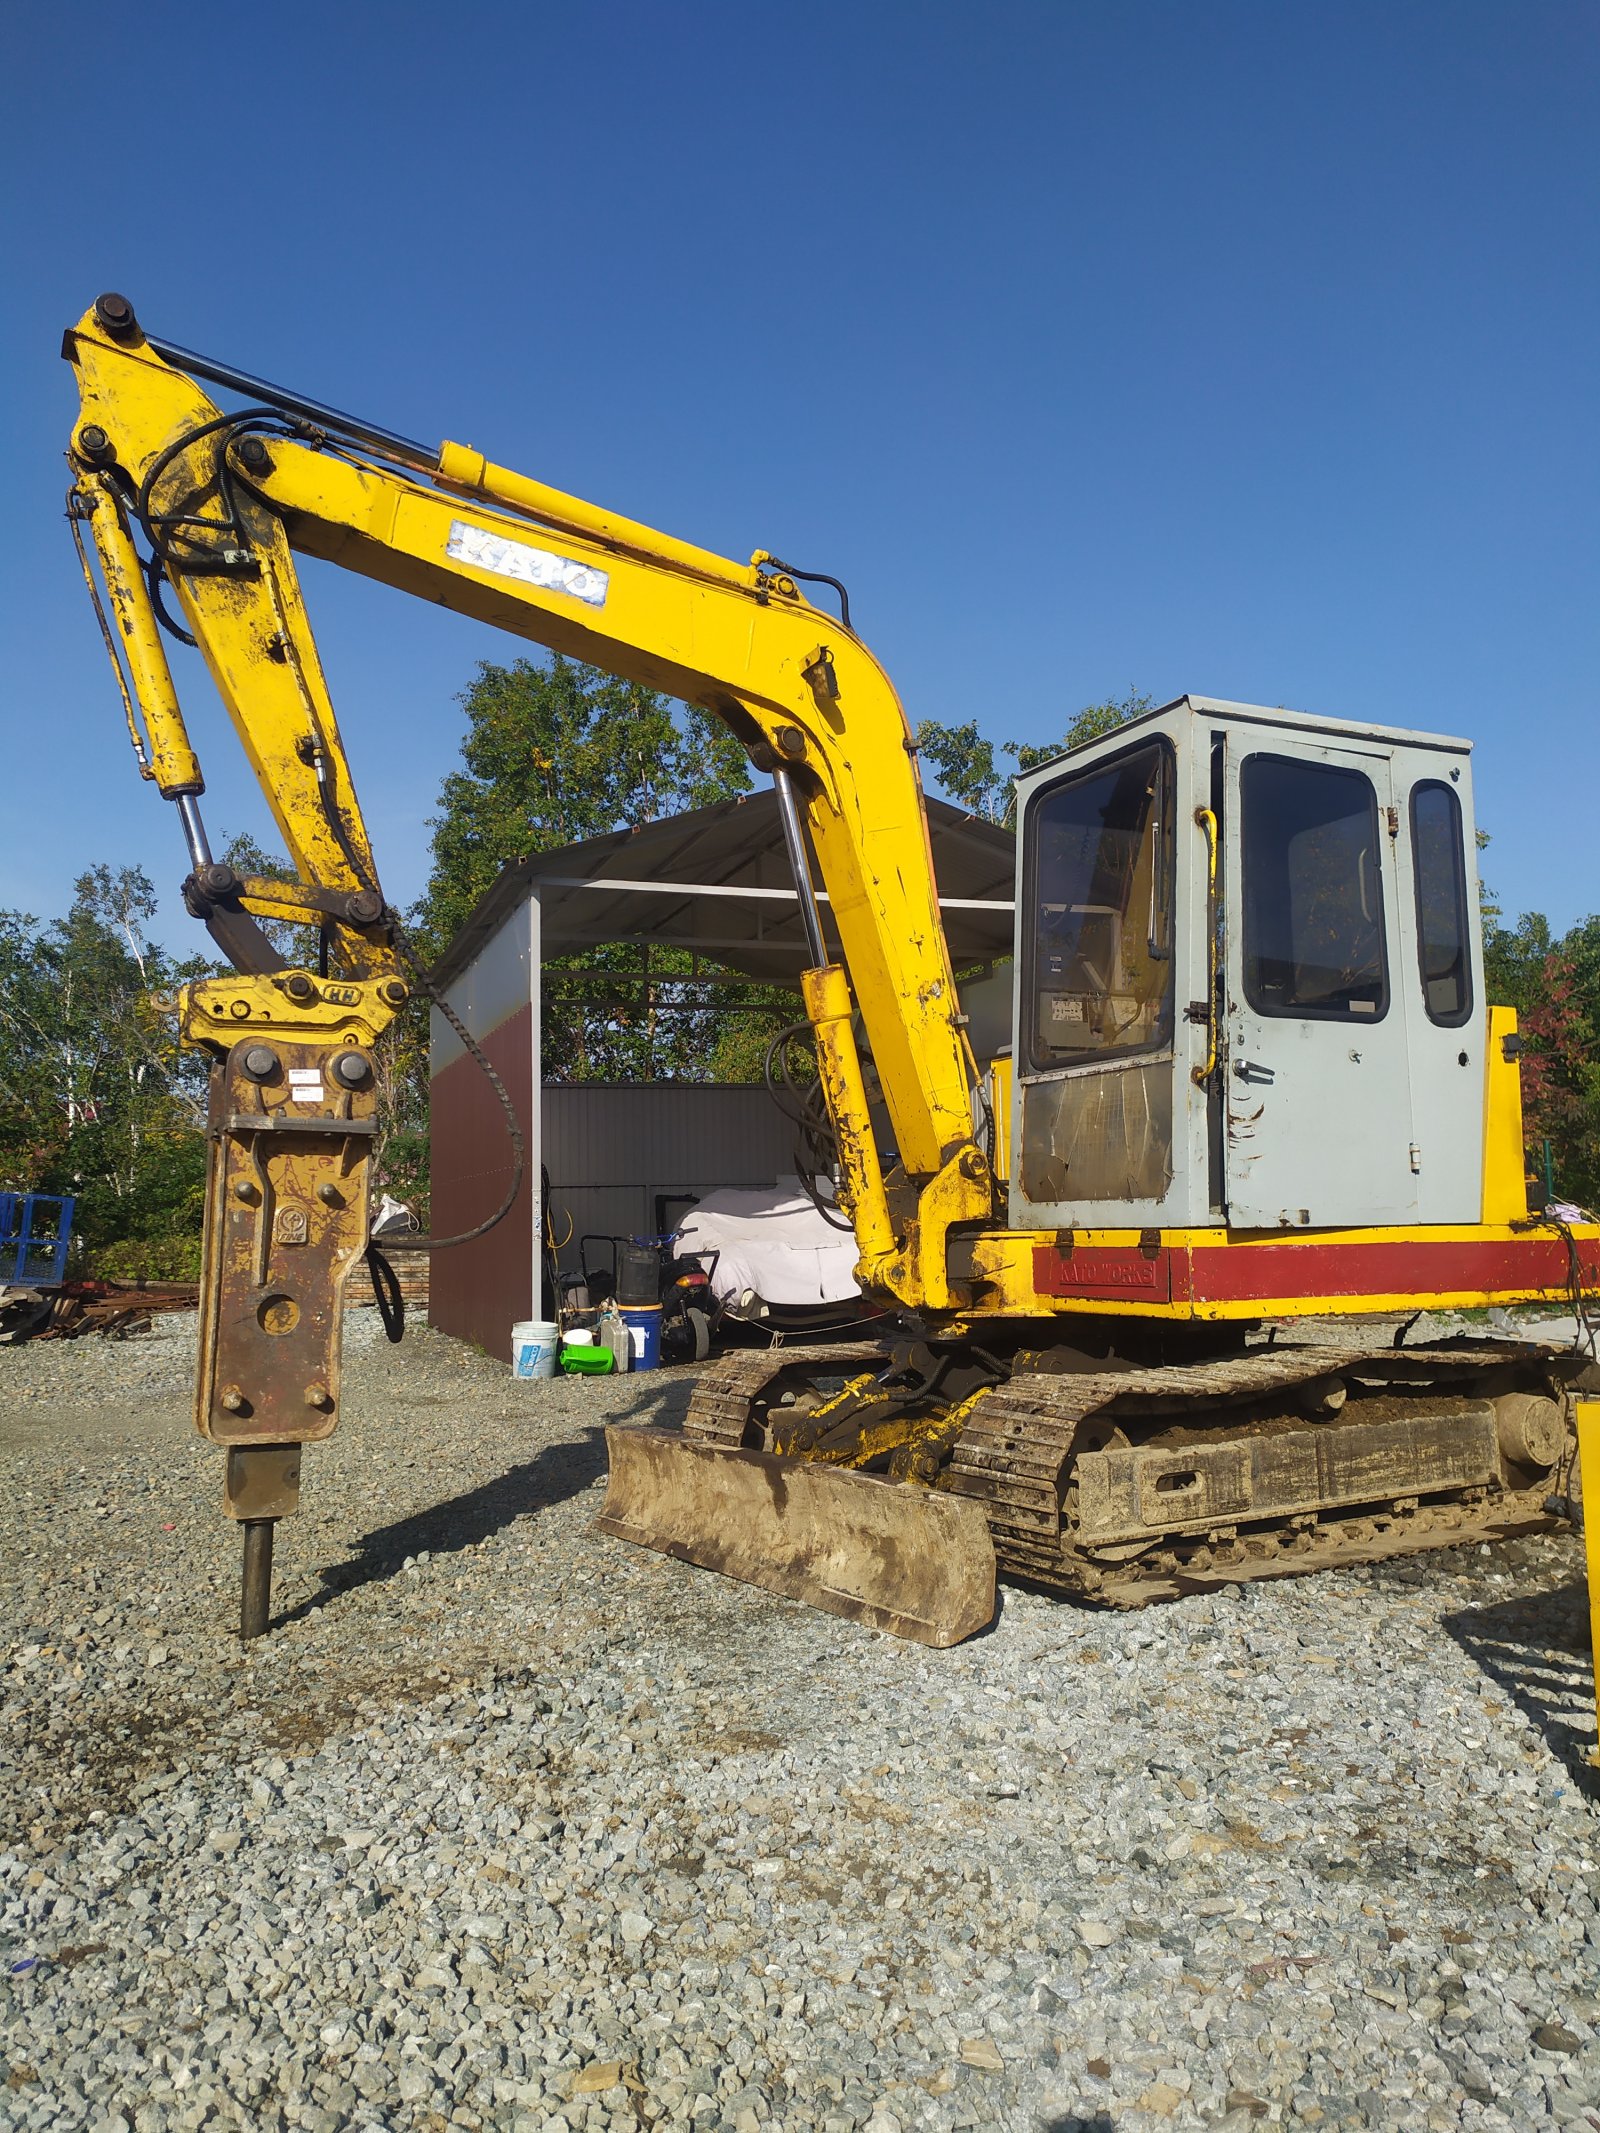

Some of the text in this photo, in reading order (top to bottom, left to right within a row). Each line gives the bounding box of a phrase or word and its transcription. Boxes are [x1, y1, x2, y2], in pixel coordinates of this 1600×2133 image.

[278, 1233, 304, 1242] FINE
[1061, 1263, 1153, 1284] KATO WORKS
